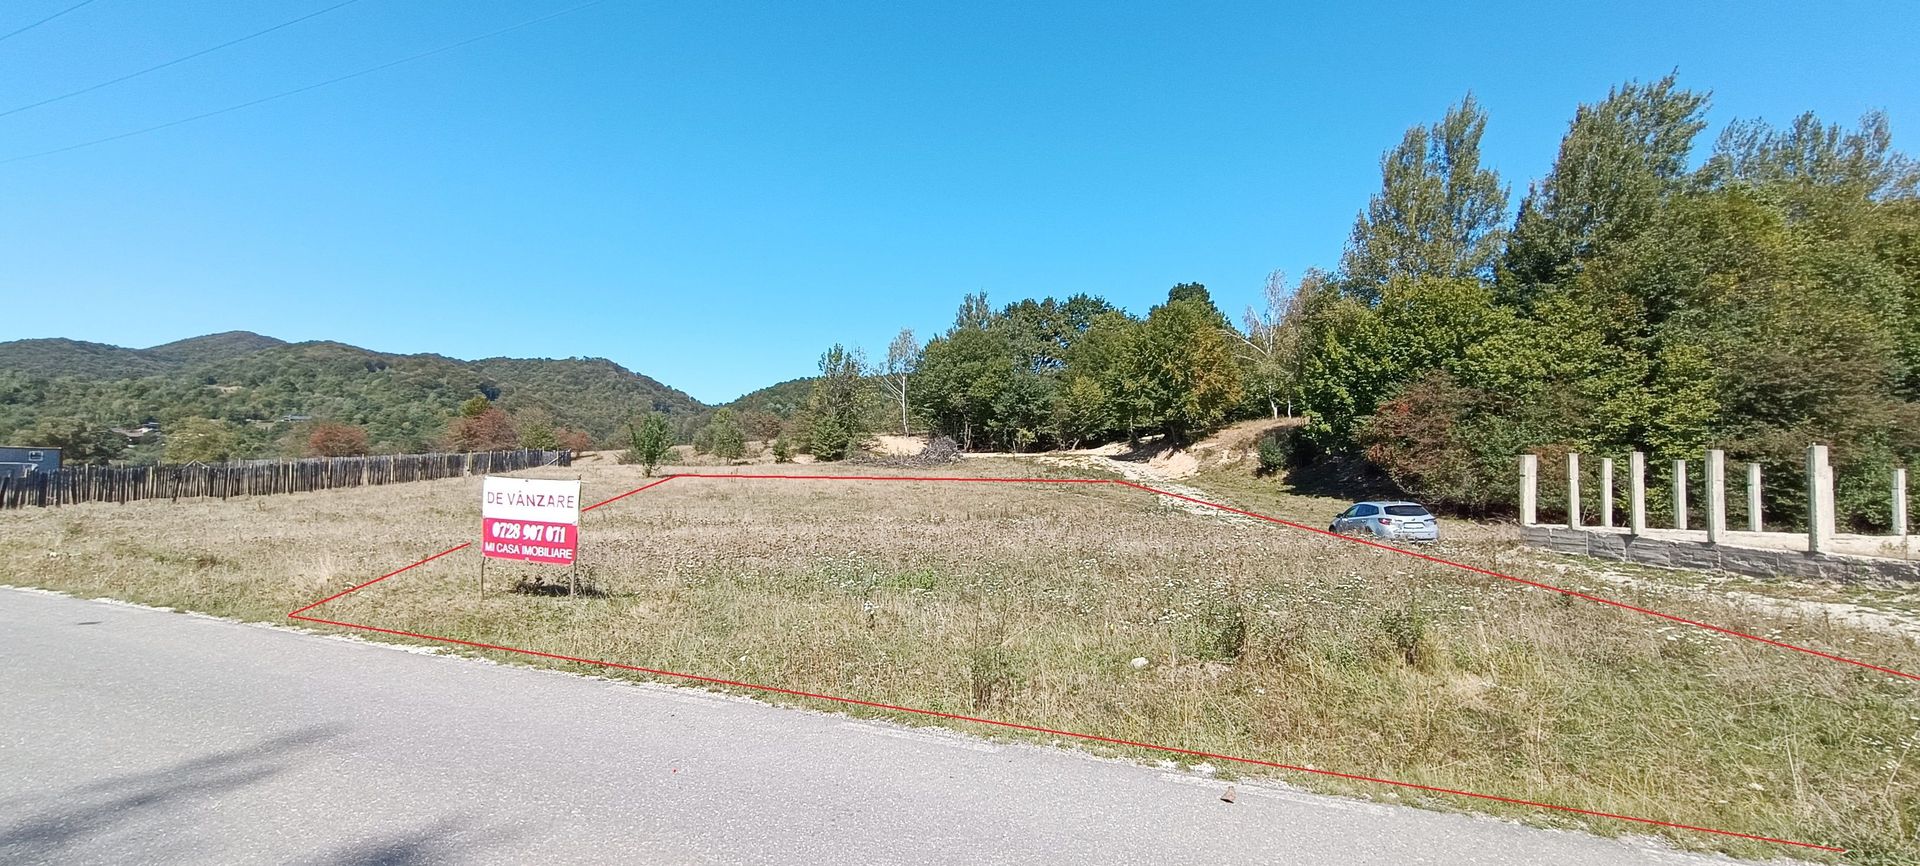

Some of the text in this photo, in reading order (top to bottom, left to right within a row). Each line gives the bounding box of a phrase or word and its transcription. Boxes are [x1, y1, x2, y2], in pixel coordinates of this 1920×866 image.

[487, 490, 574, 508] DE VÂNZARE
[492, 522, 566, 543] 0728 907 071
[485, 541, 572, 559] MI CASA IMOBILIARE
